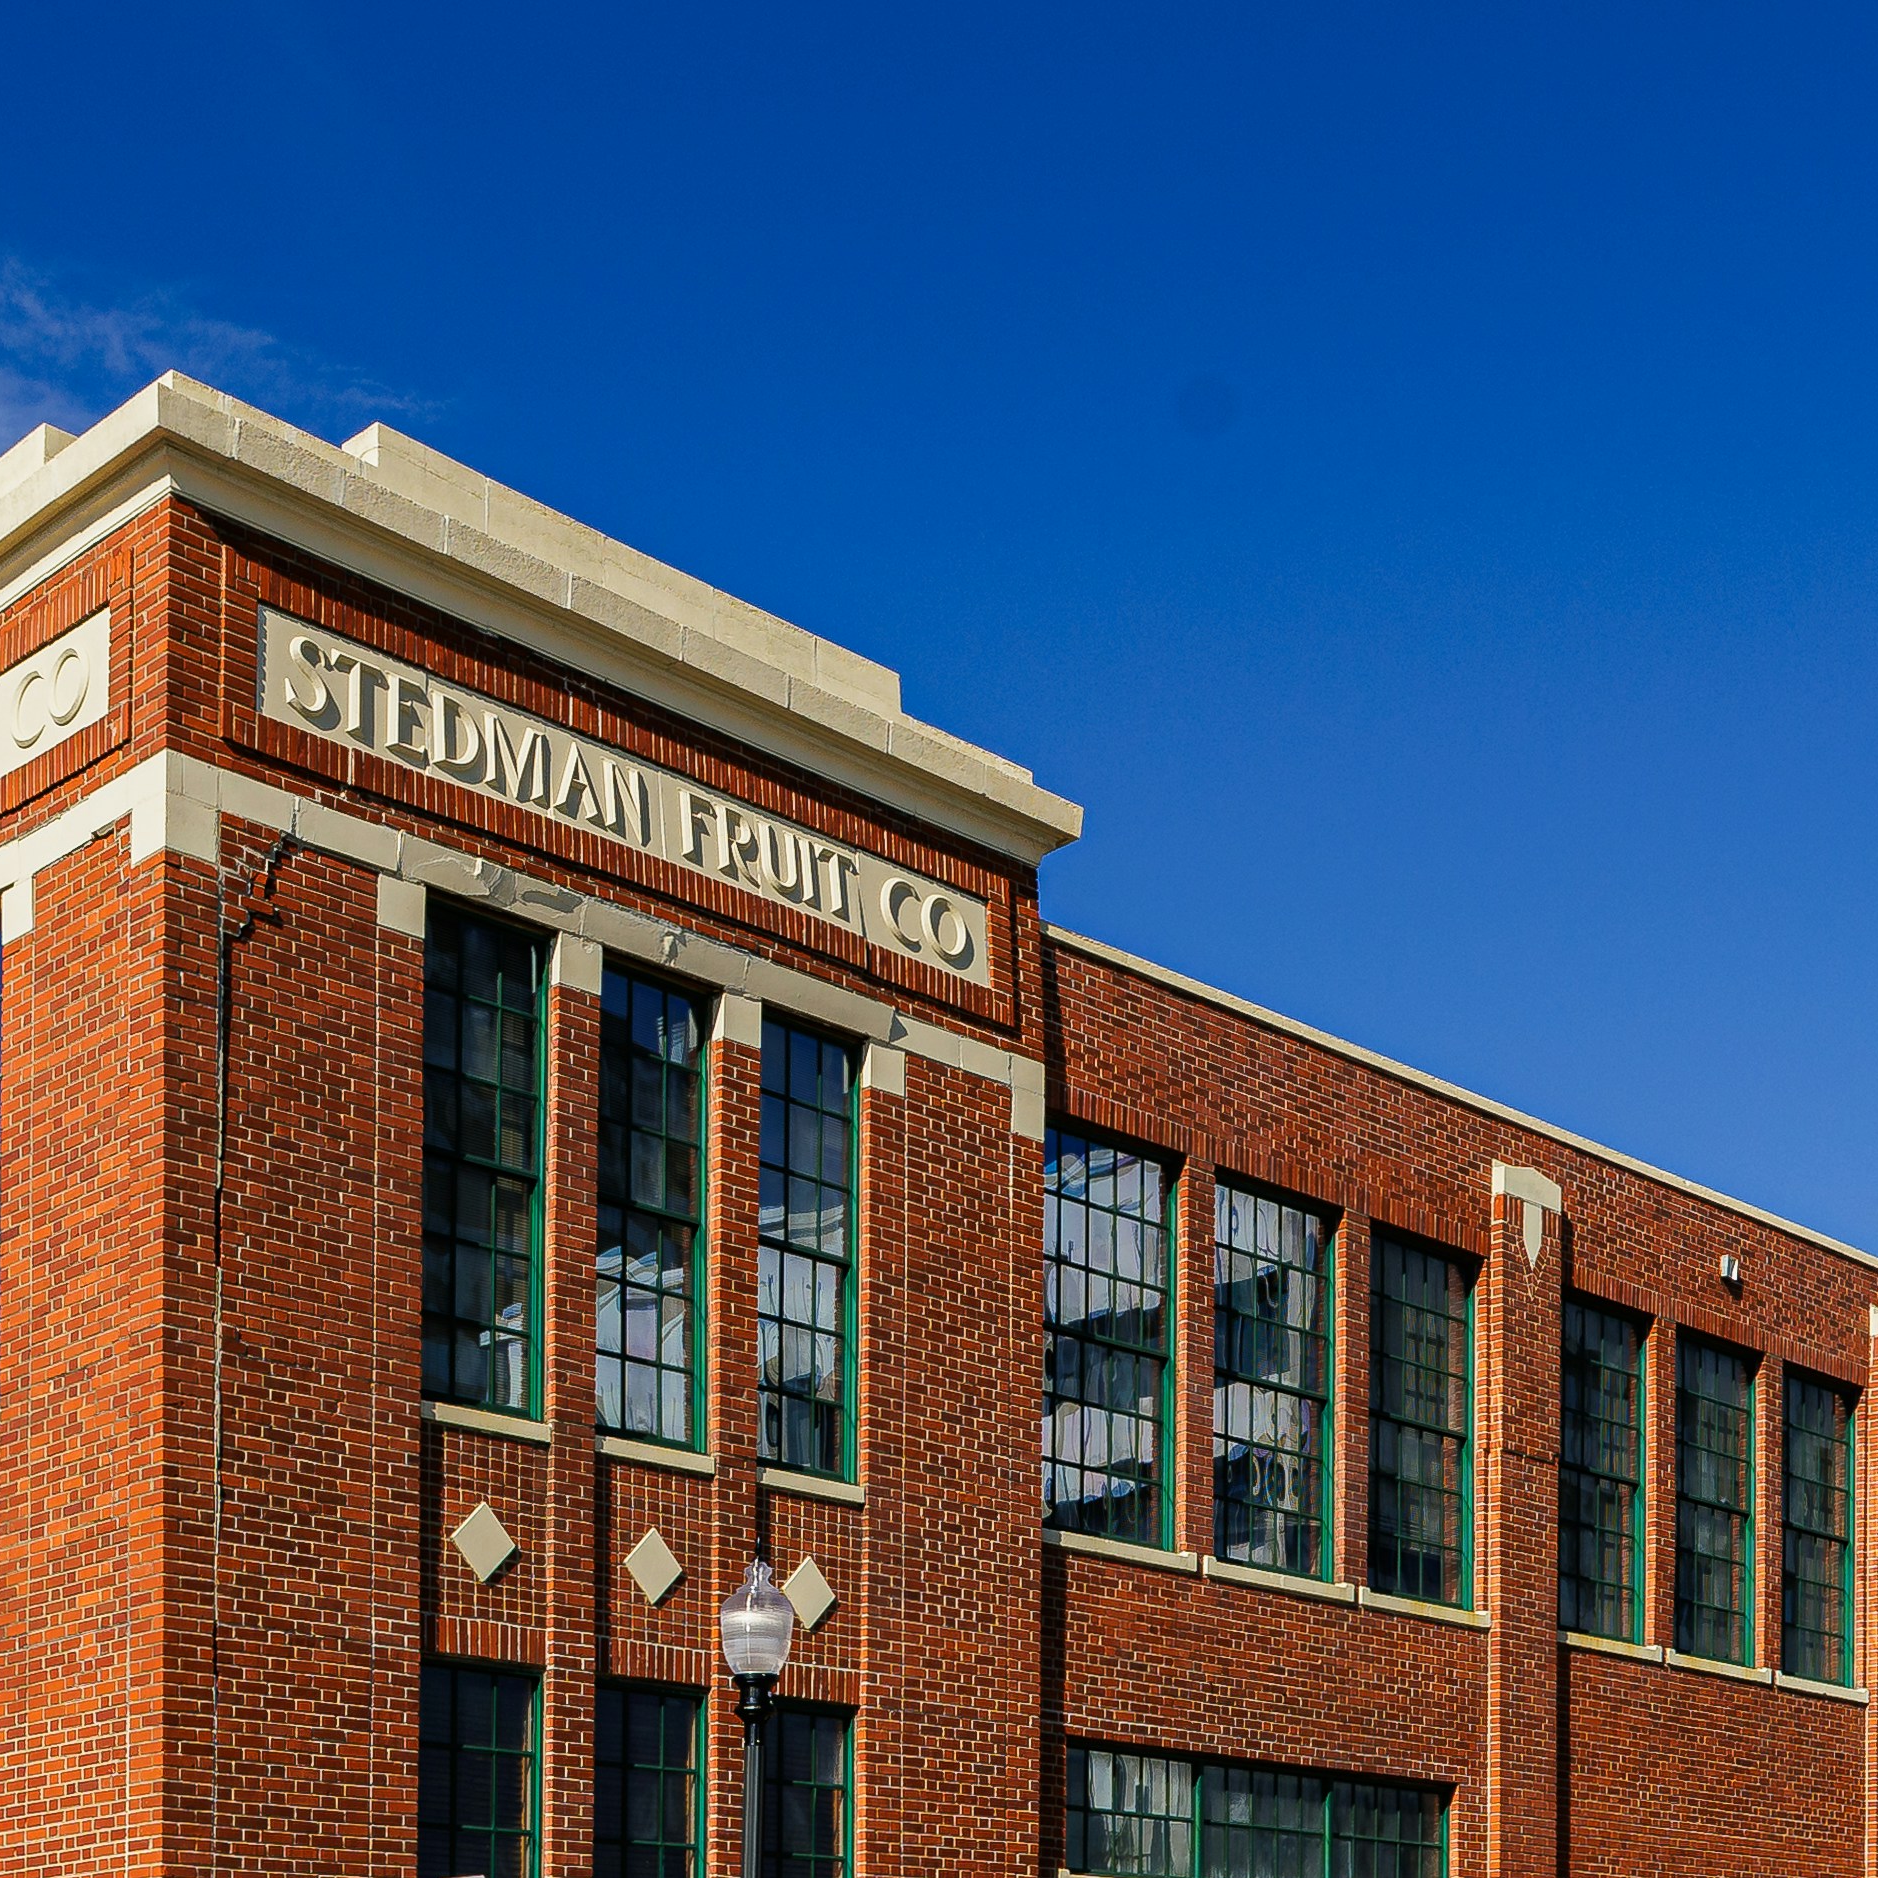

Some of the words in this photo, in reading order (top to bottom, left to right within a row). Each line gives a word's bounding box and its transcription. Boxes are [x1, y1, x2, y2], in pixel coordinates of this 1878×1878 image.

[11, 646, 91, 749] CO
[284, 635, 649, 847] STEDMAN
[679, 786, 859, 919] FRUIT
[879, 876, 970, 962] CO
